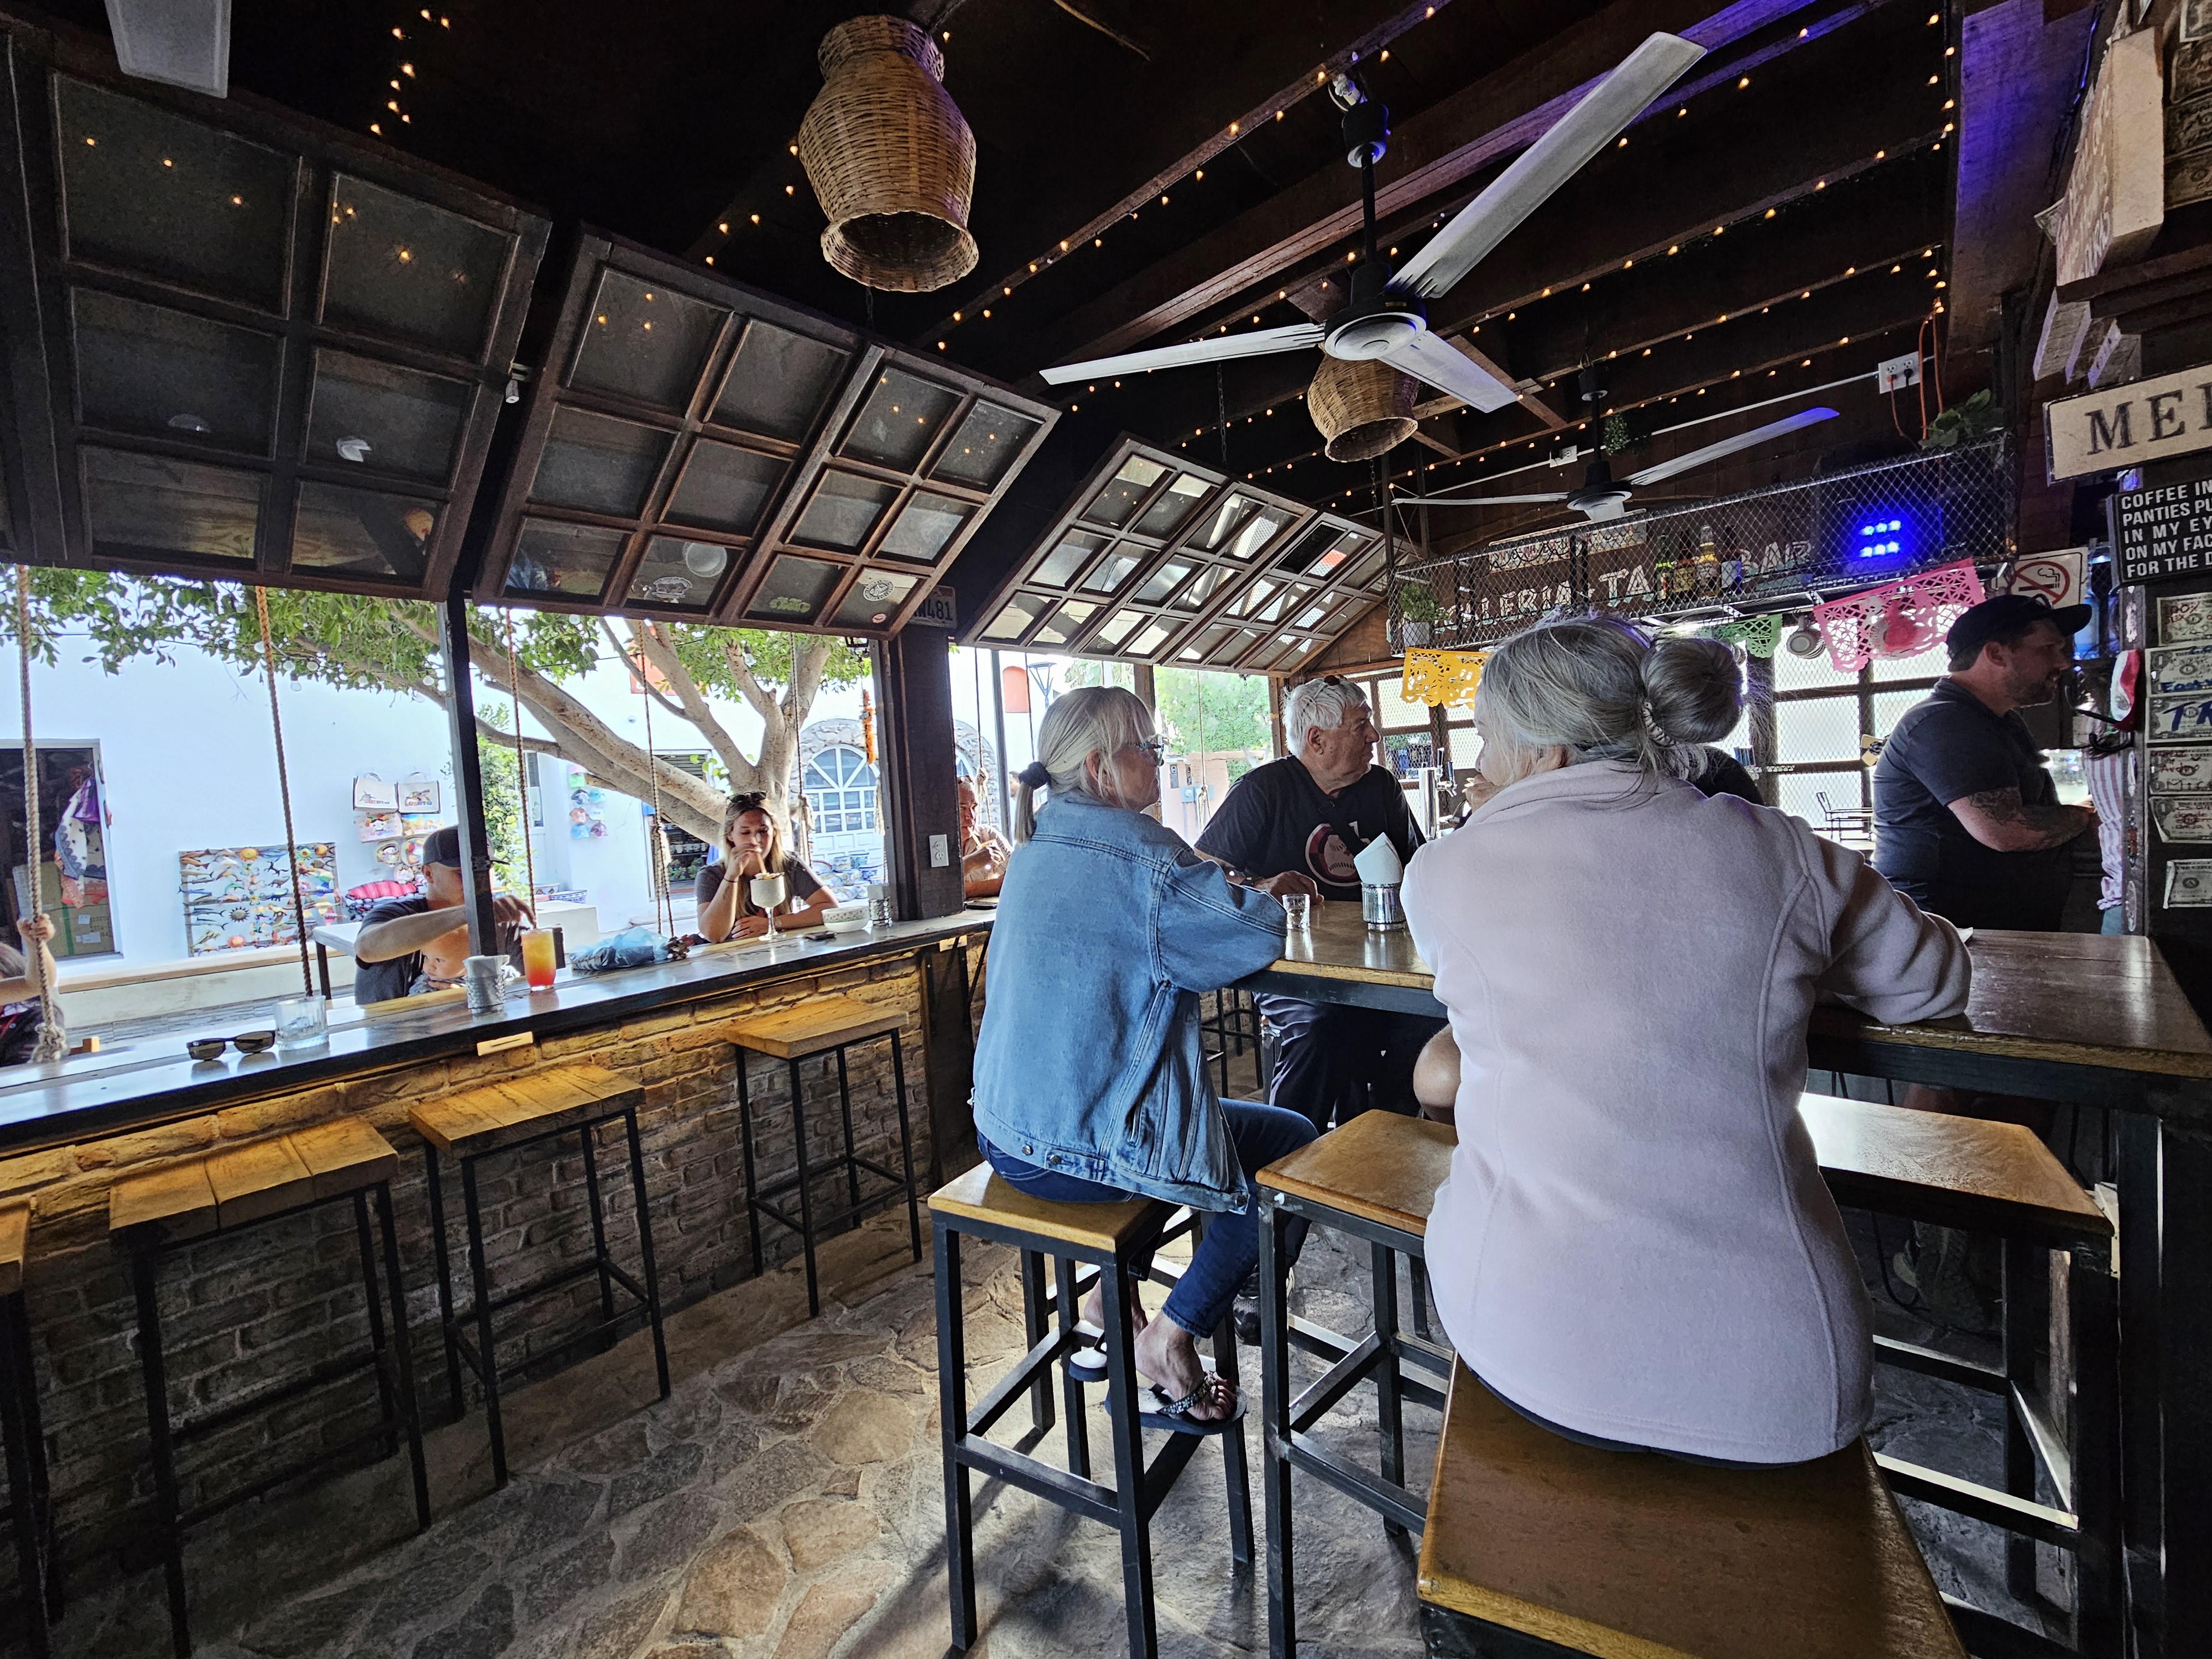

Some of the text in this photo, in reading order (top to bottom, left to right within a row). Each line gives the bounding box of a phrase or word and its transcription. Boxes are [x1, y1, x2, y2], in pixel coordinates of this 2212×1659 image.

[2121, 484, 2188, 510] COFFEE
[2122, 502, 2190, 526] PANTIES
[2124, 528, 2143, 544] IN
[2152, 521, 2180, 539] MY
[2126, 545, 2147, 561] ON
[2153, 539, 2178, 556] MY
[2127, 561, 2159, 578] FOR
[2164, 554, 2199, 572] THE
